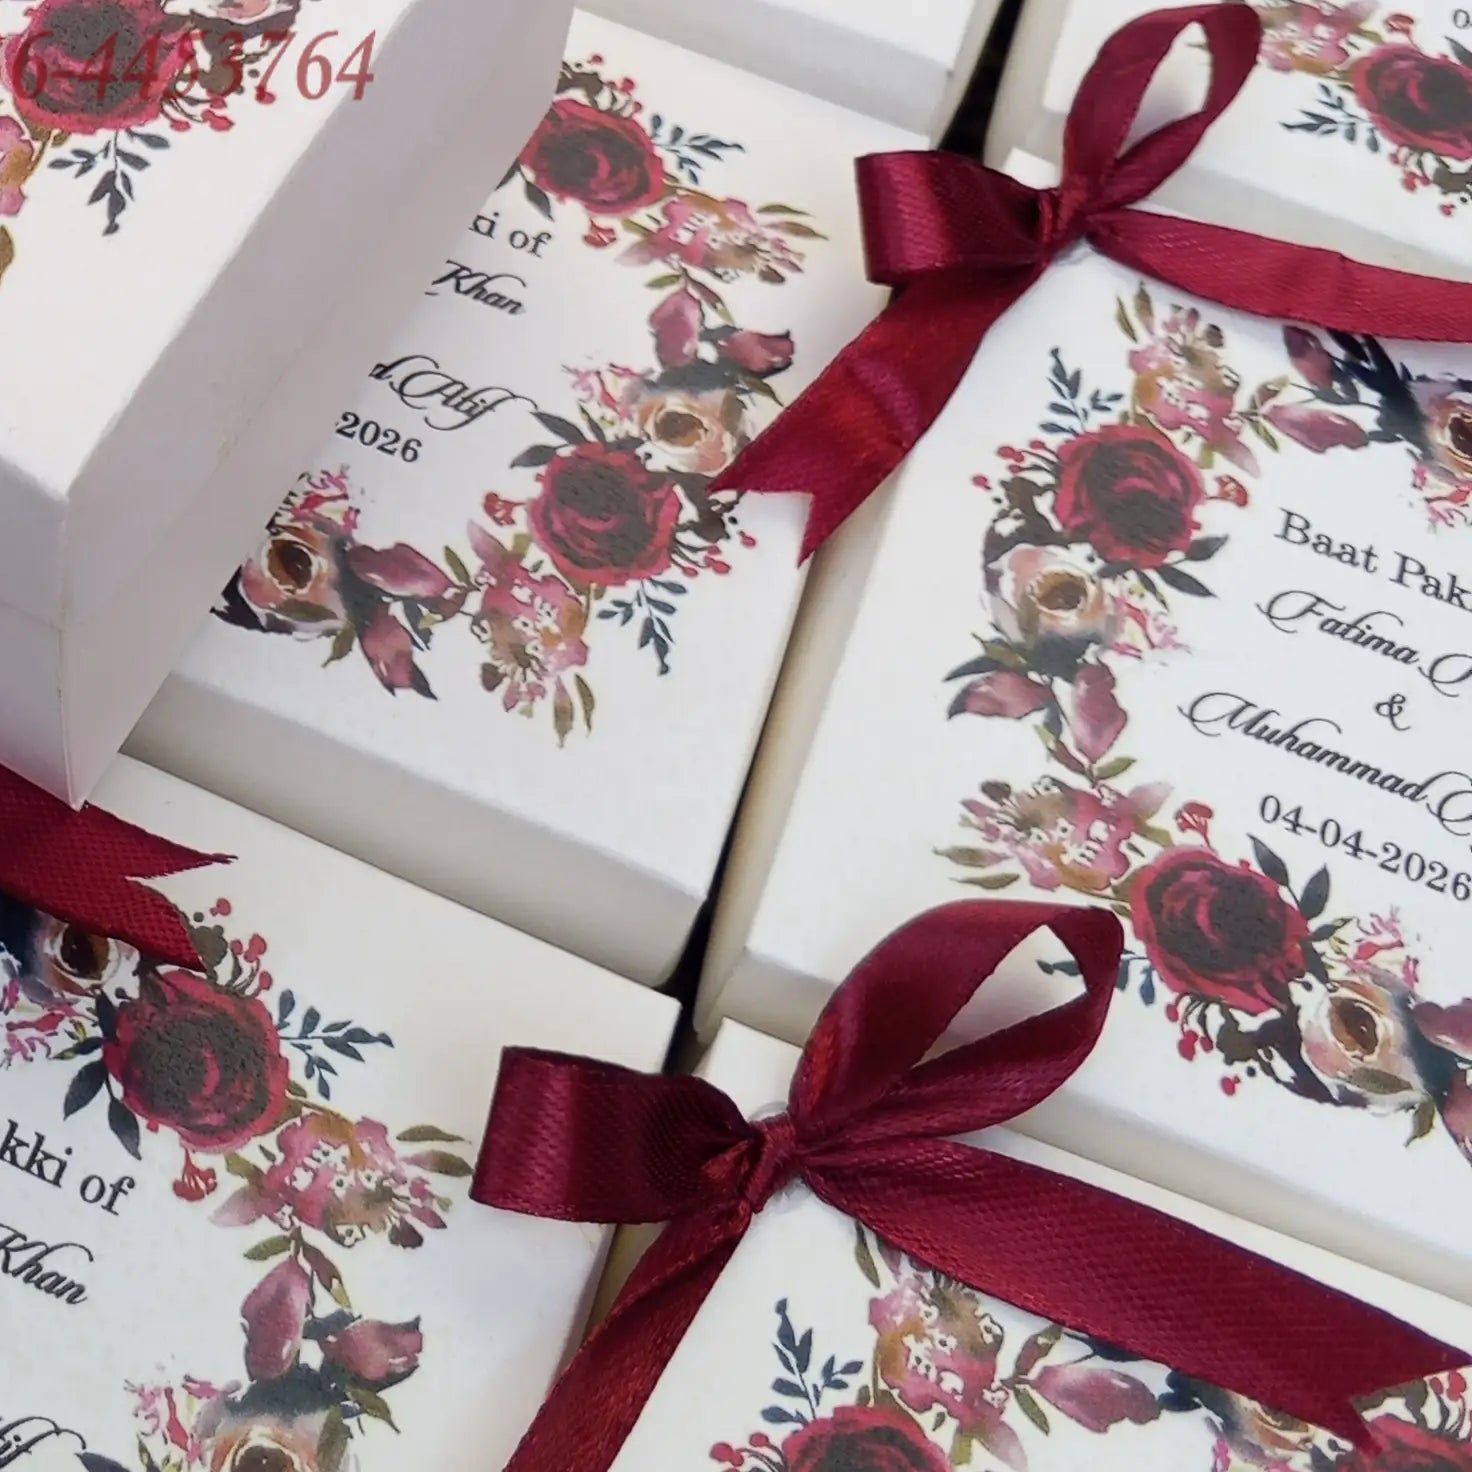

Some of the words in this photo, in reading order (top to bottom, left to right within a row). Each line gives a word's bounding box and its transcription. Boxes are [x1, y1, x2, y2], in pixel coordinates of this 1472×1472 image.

[509, 230, 552, 259] of
[1274, 508, 1379, 574] Baat
[1388, 550, 1472, 613] Pak
[1255, 590, 1420, 665] Fatima
[1177, 691, 1472, 803] Muhammad
[1376, 693, 1410, 732] &
[1259, 794, 1472, 901] 04-04-2026
[79, 1173, 136, 1216] of
